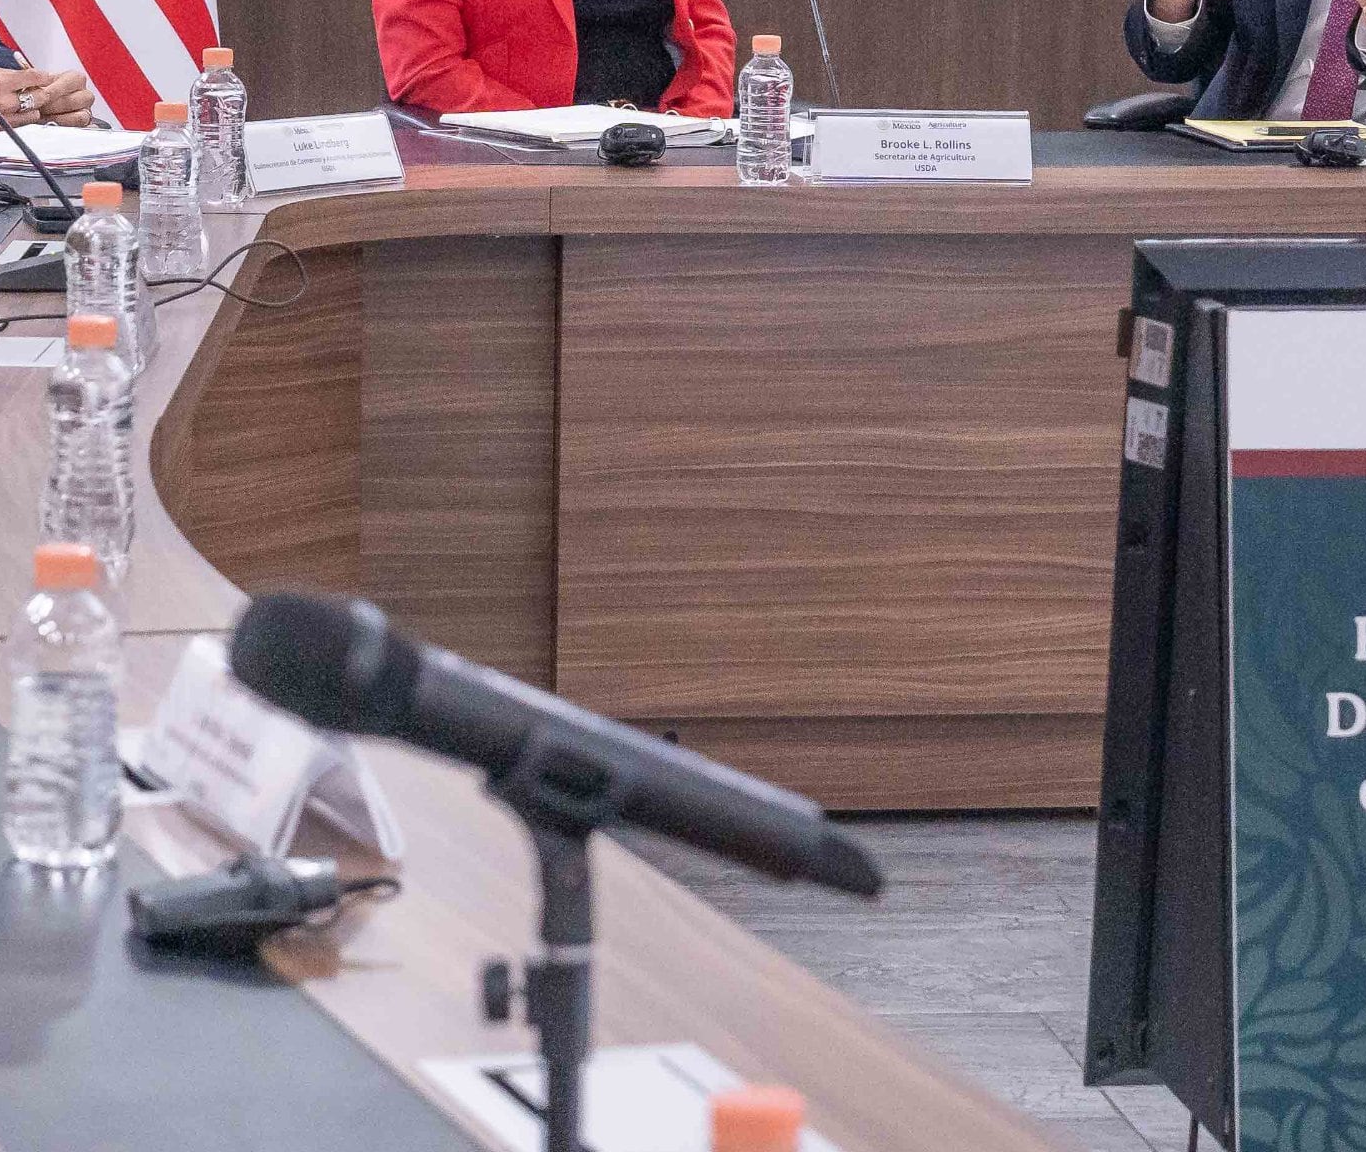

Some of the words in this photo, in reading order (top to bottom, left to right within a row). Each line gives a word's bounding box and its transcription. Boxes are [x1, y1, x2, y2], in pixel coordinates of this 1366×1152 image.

[293, 143, 313, 151] Luke
[881, 140, 920, 148] Brooke
[924, 141, 932, 149] L.
[935, 141, 971, 149] Rollins
[930, 154, 975, 162] Agricultura
